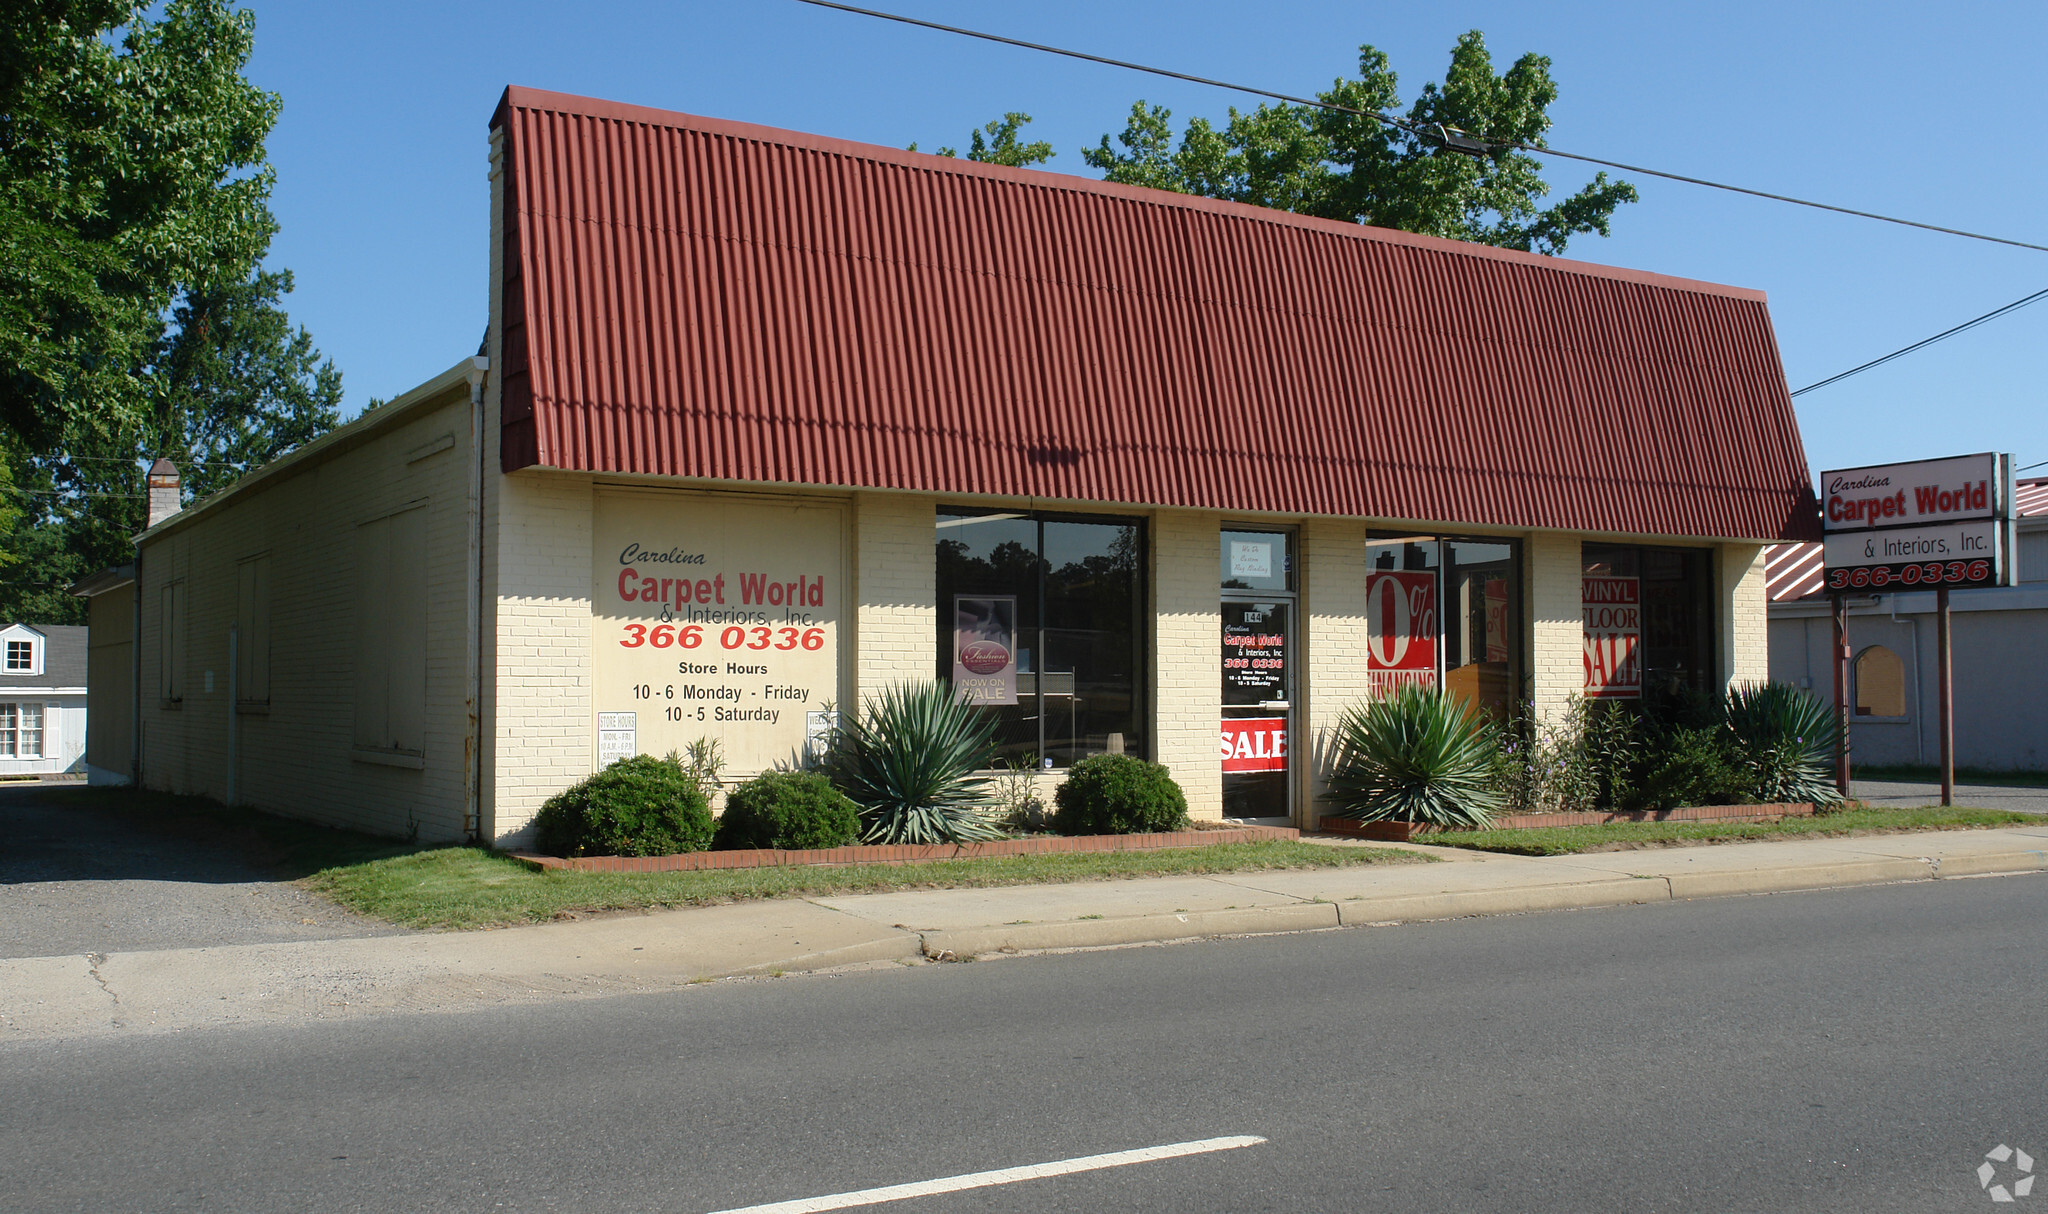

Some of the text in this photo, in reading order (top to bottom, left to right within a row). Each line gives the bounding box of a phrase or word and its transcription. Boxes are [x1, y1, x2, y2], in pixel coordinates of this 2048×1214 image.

[1829, 475, 1890, 494] Carolina
[1828, 480, 1988, 526] Carpet World
[620, 542, 707, 566] Carolina
[1864, 532, 1988, 558] & Interiors, Inc.
[1828, 560, 1990, 589] 366-0336
[618, 567, 824, 611] Carpet World
[1582, 583, 1634, 602] VINYL
[660, 603, 816, 627] & Interiors, Inc.
[1246, 612, 1262, 621] 144
[1367, 574, 1434, 668] 0%
[1582, 606, 1638, 629] FLOOR
[620, 624, 826, 651] 366 0336
[1224, 624, 1250, 632] Carolina
[1224, 632, 1284, 648] Carpet World
[965, 646, 1006, 660] Fashion
[1583, 632, 1639, 686] SALE
[678, 662, 768, 674] Store Hours
[1224, 658, 1284, 668] 366 0336
[962, 678, 1006, 687] NOW ON
[632, 684, 650, 700] 10
[665, 684, 674, 700] 6
[683, 684, 742, 703] Monday
[764, 684, 810, 703] Friday
[962, 687, 1006, 700] SALE
[665, 706, 682, 722] 10
[697, 706, 706, 722] 5
[714, 706, 780, 724] Saturday
[1220, 731, 1288, 760] SALE
